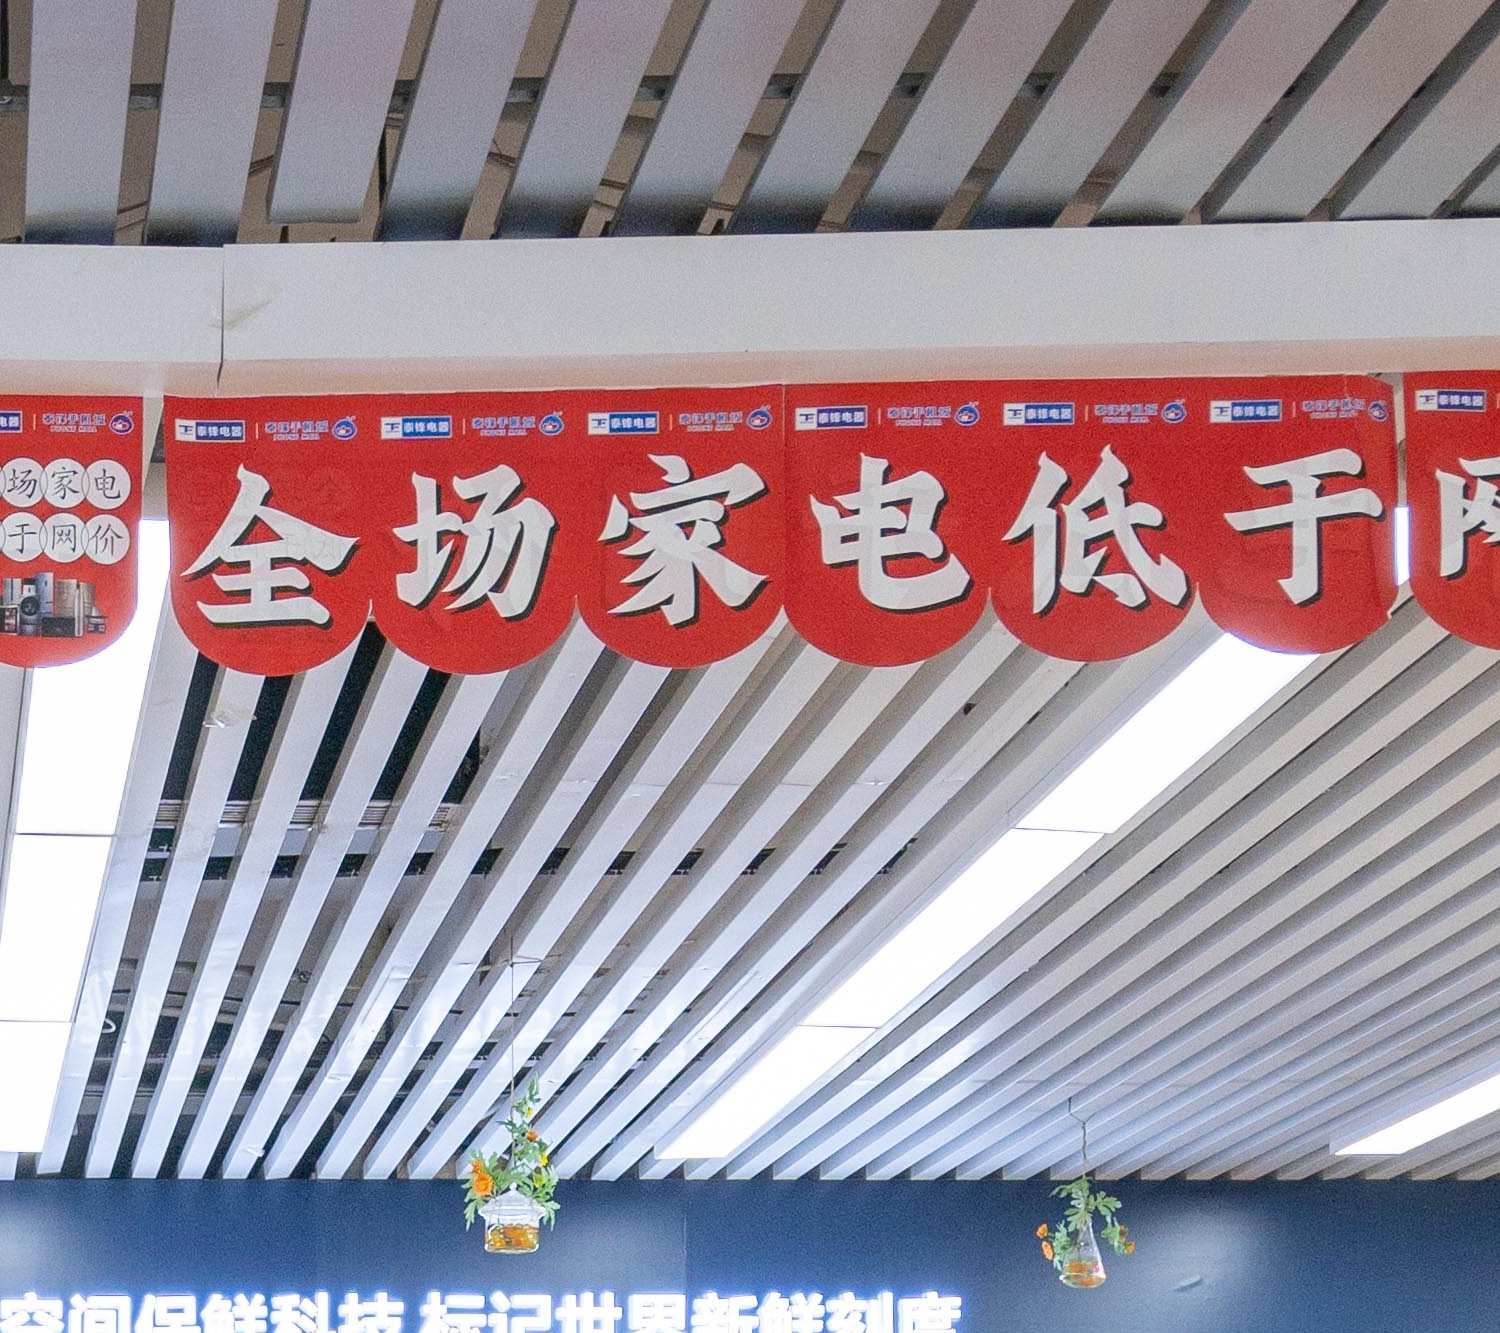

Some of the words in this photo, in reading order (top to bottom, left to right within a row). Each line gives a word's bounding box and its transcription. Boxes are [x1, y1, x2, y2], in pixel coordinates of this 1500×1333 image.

[196, 423, 244, 438] 泰锋电器
[403, 420, 450, 436] 泰锋电器
[610, 416, 657, 432] 泰锋电器
